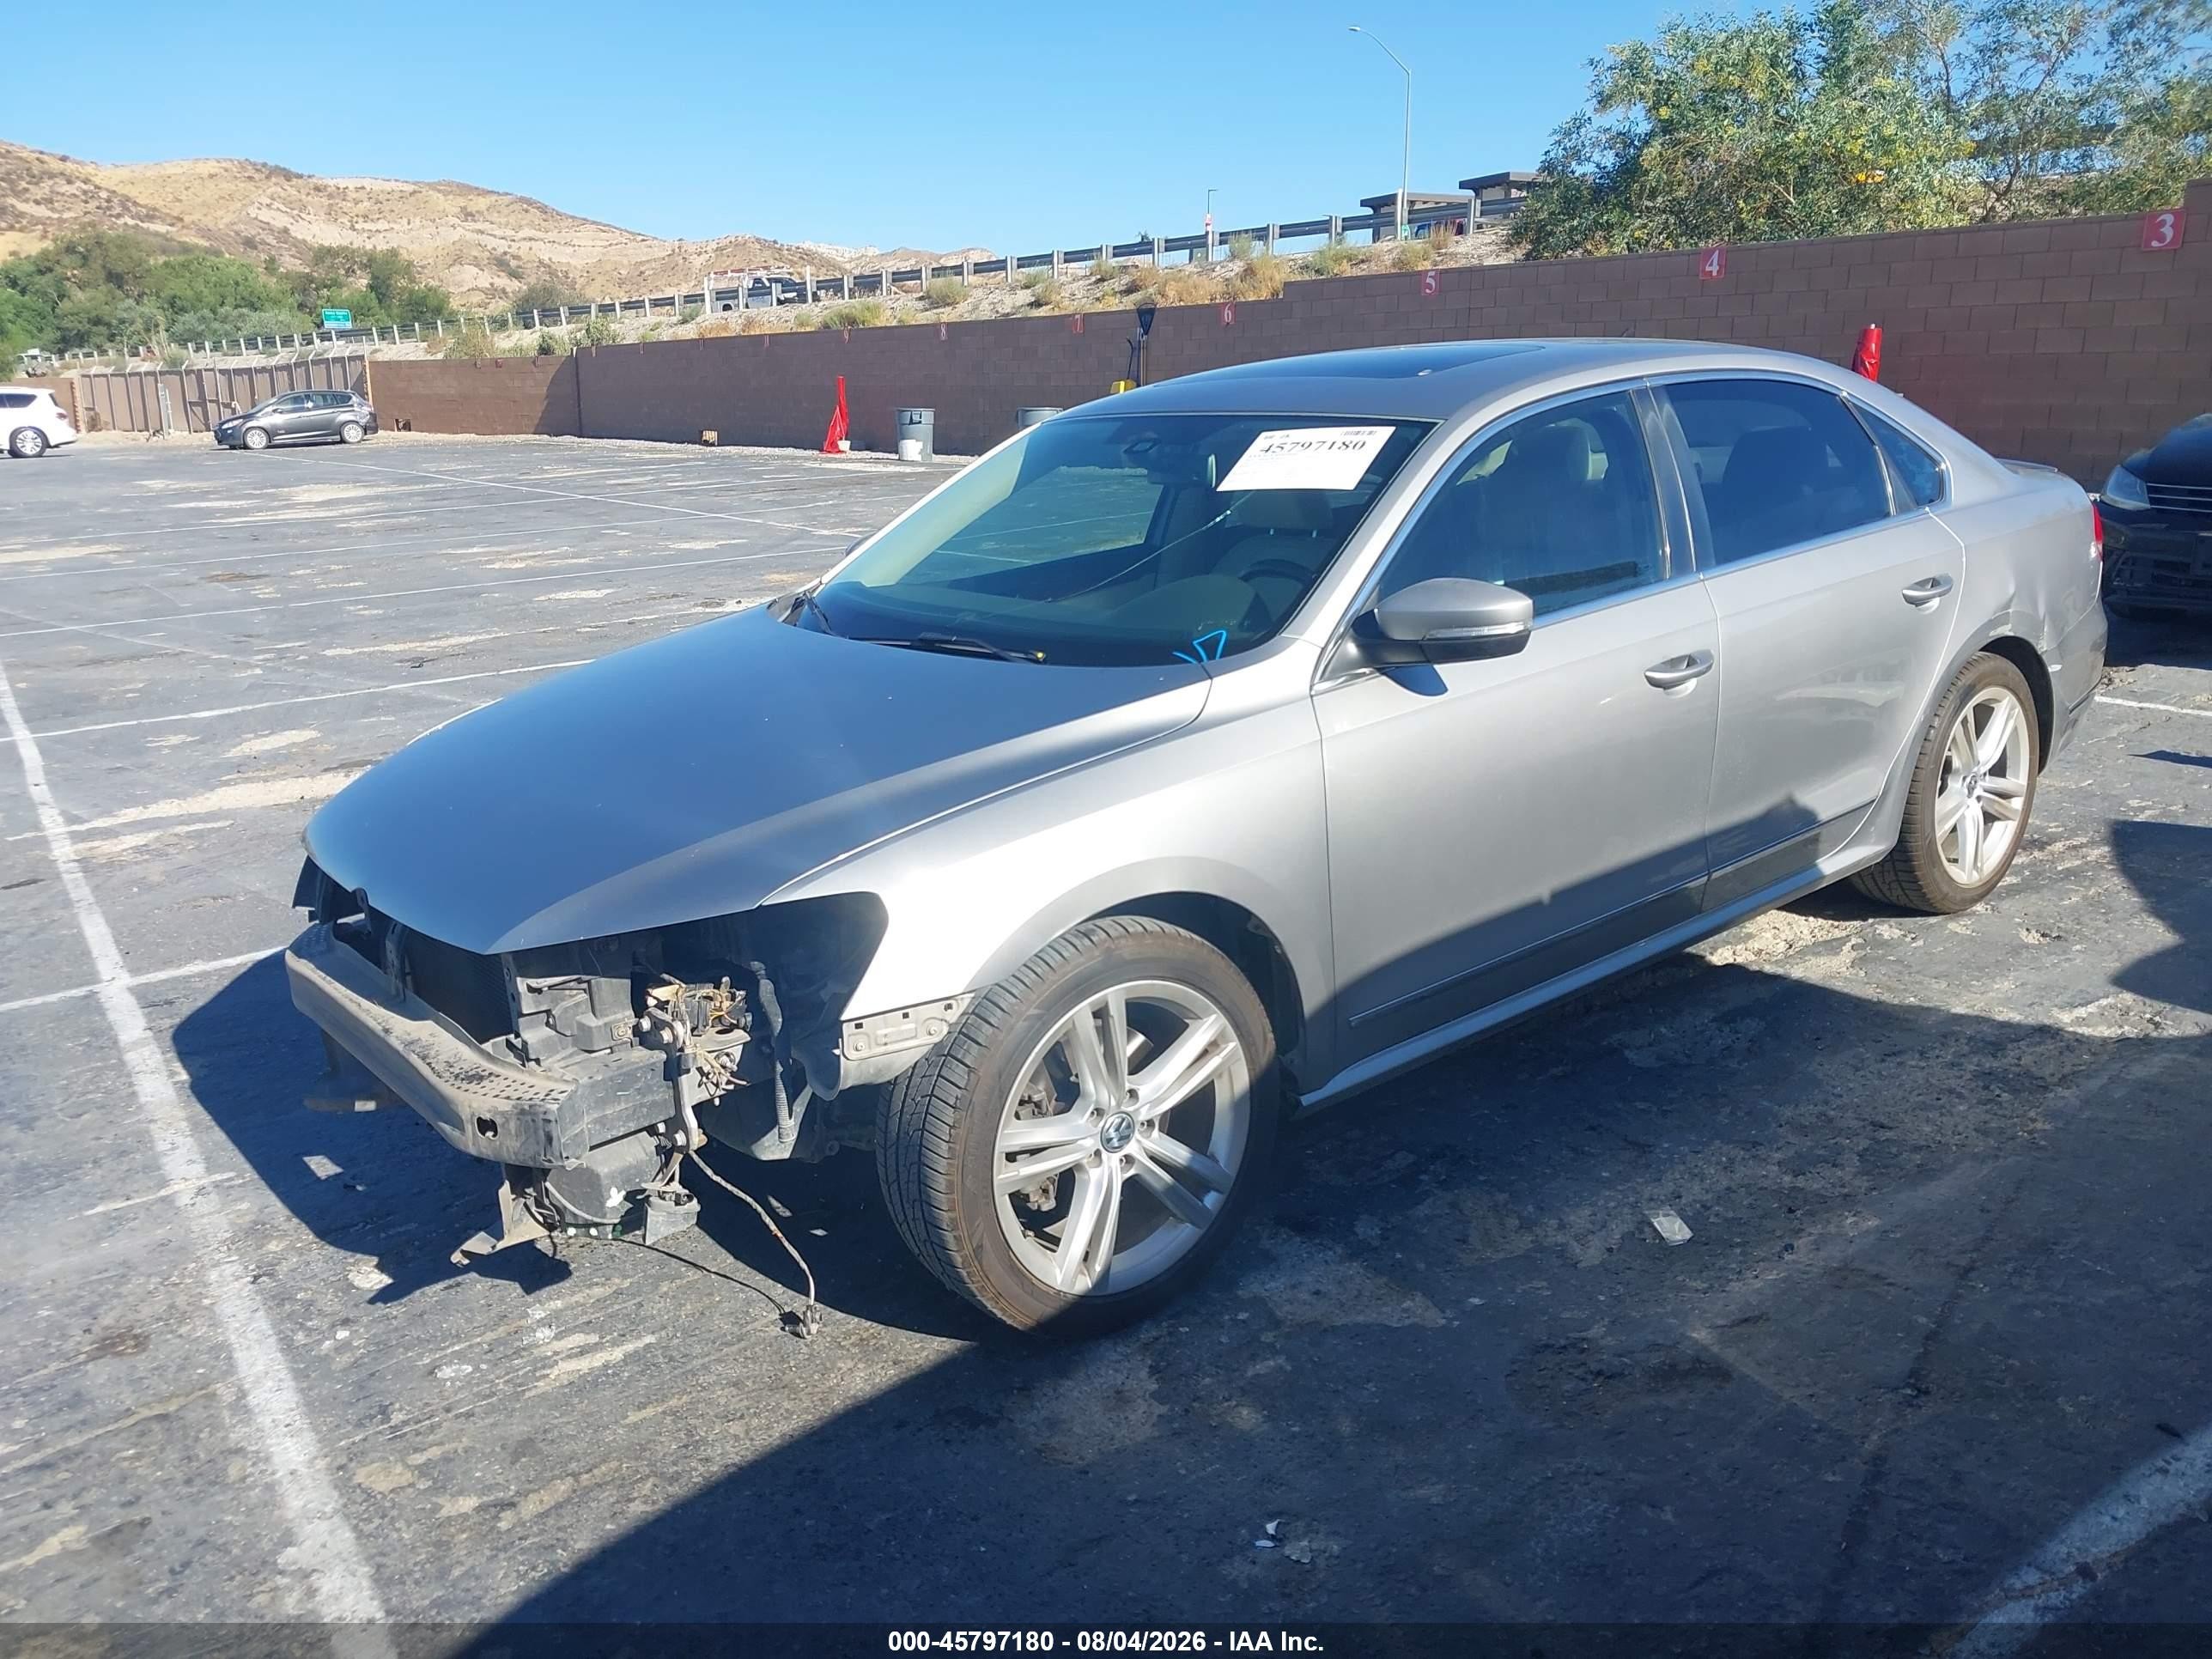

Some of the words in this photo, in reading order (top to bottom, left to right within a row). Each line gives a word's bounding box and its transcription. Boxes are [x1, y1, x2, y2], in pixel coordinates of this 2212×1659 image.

[2151, 213, 2174, 247] 3
[1705, 249, 1720, 276] 4
[1425, 270, 1436, 294] 5
[1074, 313, 1081, 331] 7
[1224, 302, 1231, 323] 6
[940, 323, 946, 341] 8
[1260, 440, 1367, 454] 45797180
